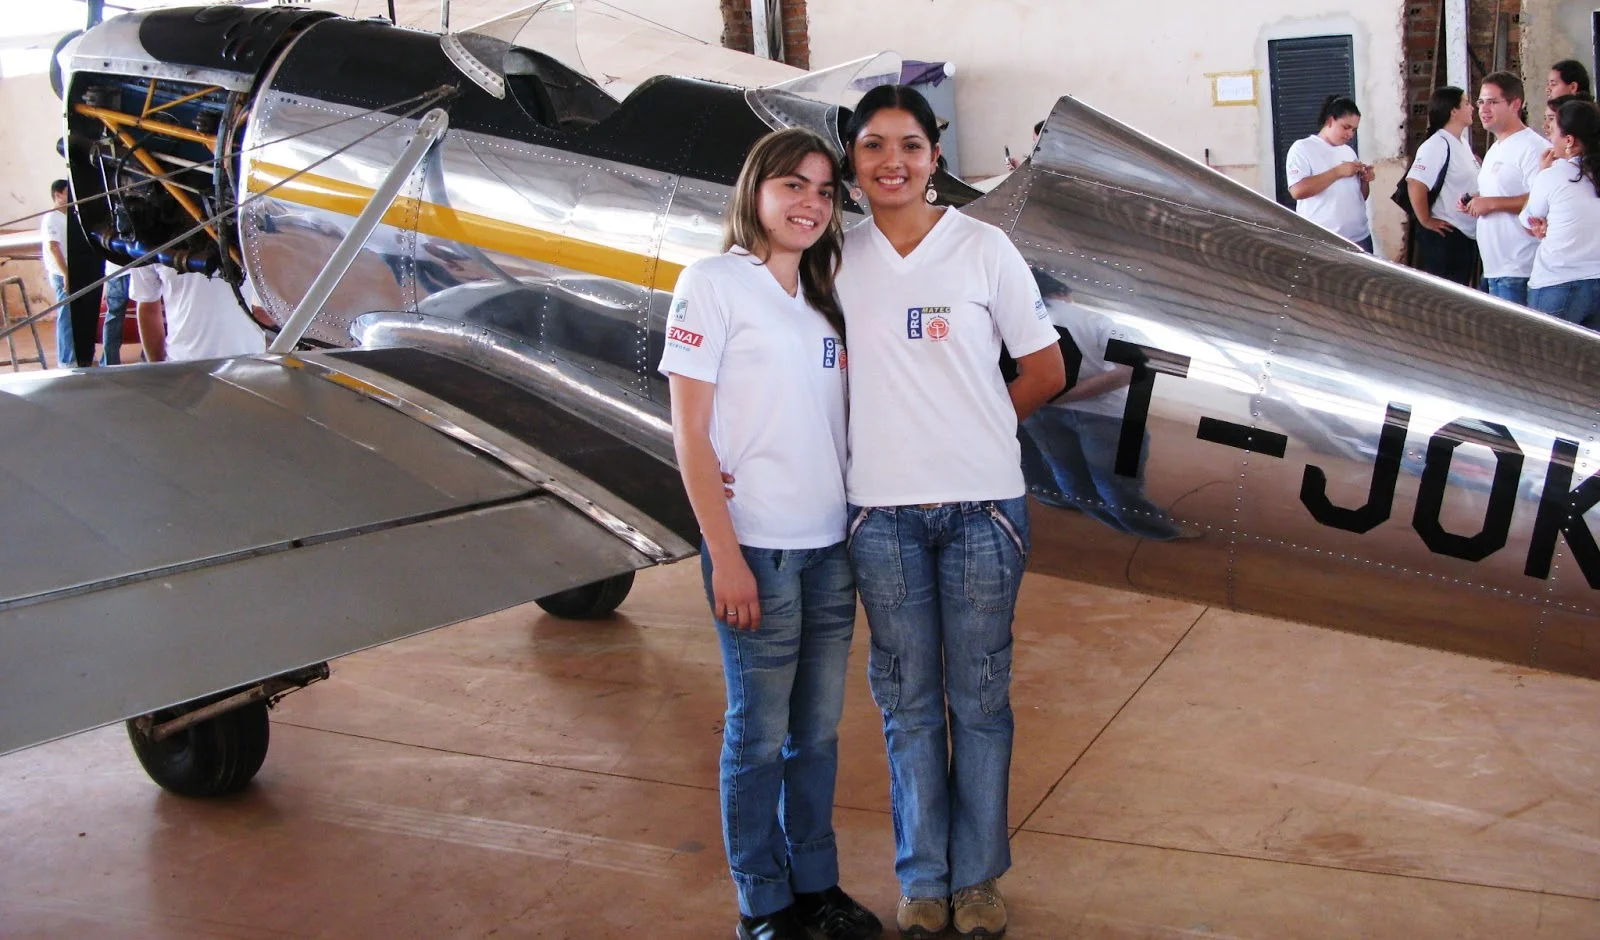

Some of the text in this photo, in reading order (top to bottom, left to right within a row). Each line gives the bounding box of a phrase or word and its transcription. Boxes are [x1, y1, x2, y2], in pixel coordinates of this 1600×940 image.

[667, 327, 700, 346] ENAI
[910, 309, 920, 338] PRO
[825, 339, 834, 367] PRO
